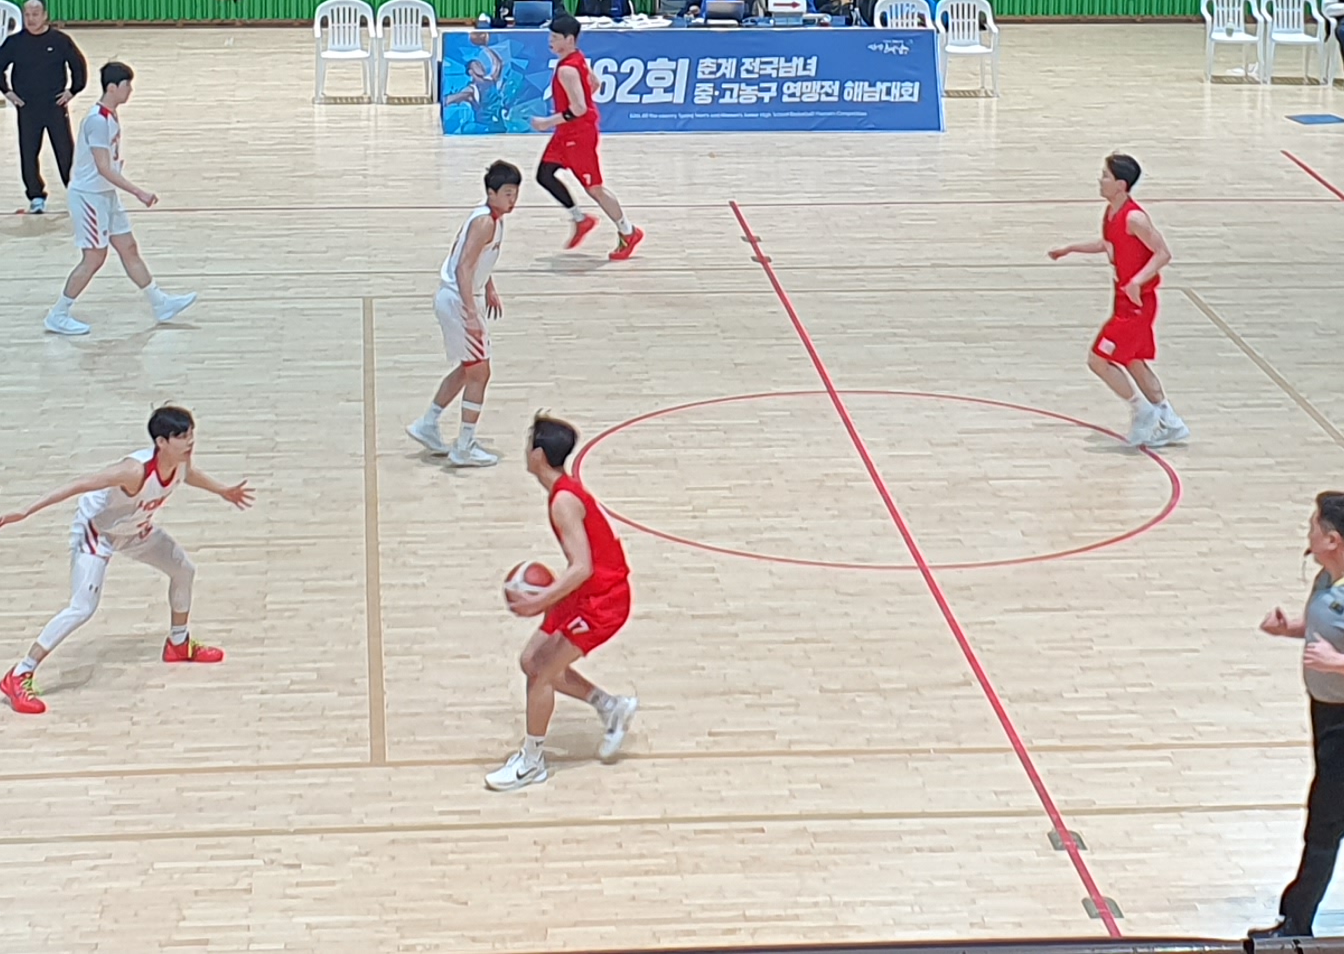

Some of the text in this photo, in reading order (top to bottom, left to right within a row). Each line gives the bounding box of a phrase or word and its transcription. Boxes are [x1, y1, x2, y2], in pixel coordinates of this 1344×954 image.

[696, 56, 818, 77] 춘계 전국남녀
[694, 81, 921, 104] 중·고농구 연맹전 해남대회
